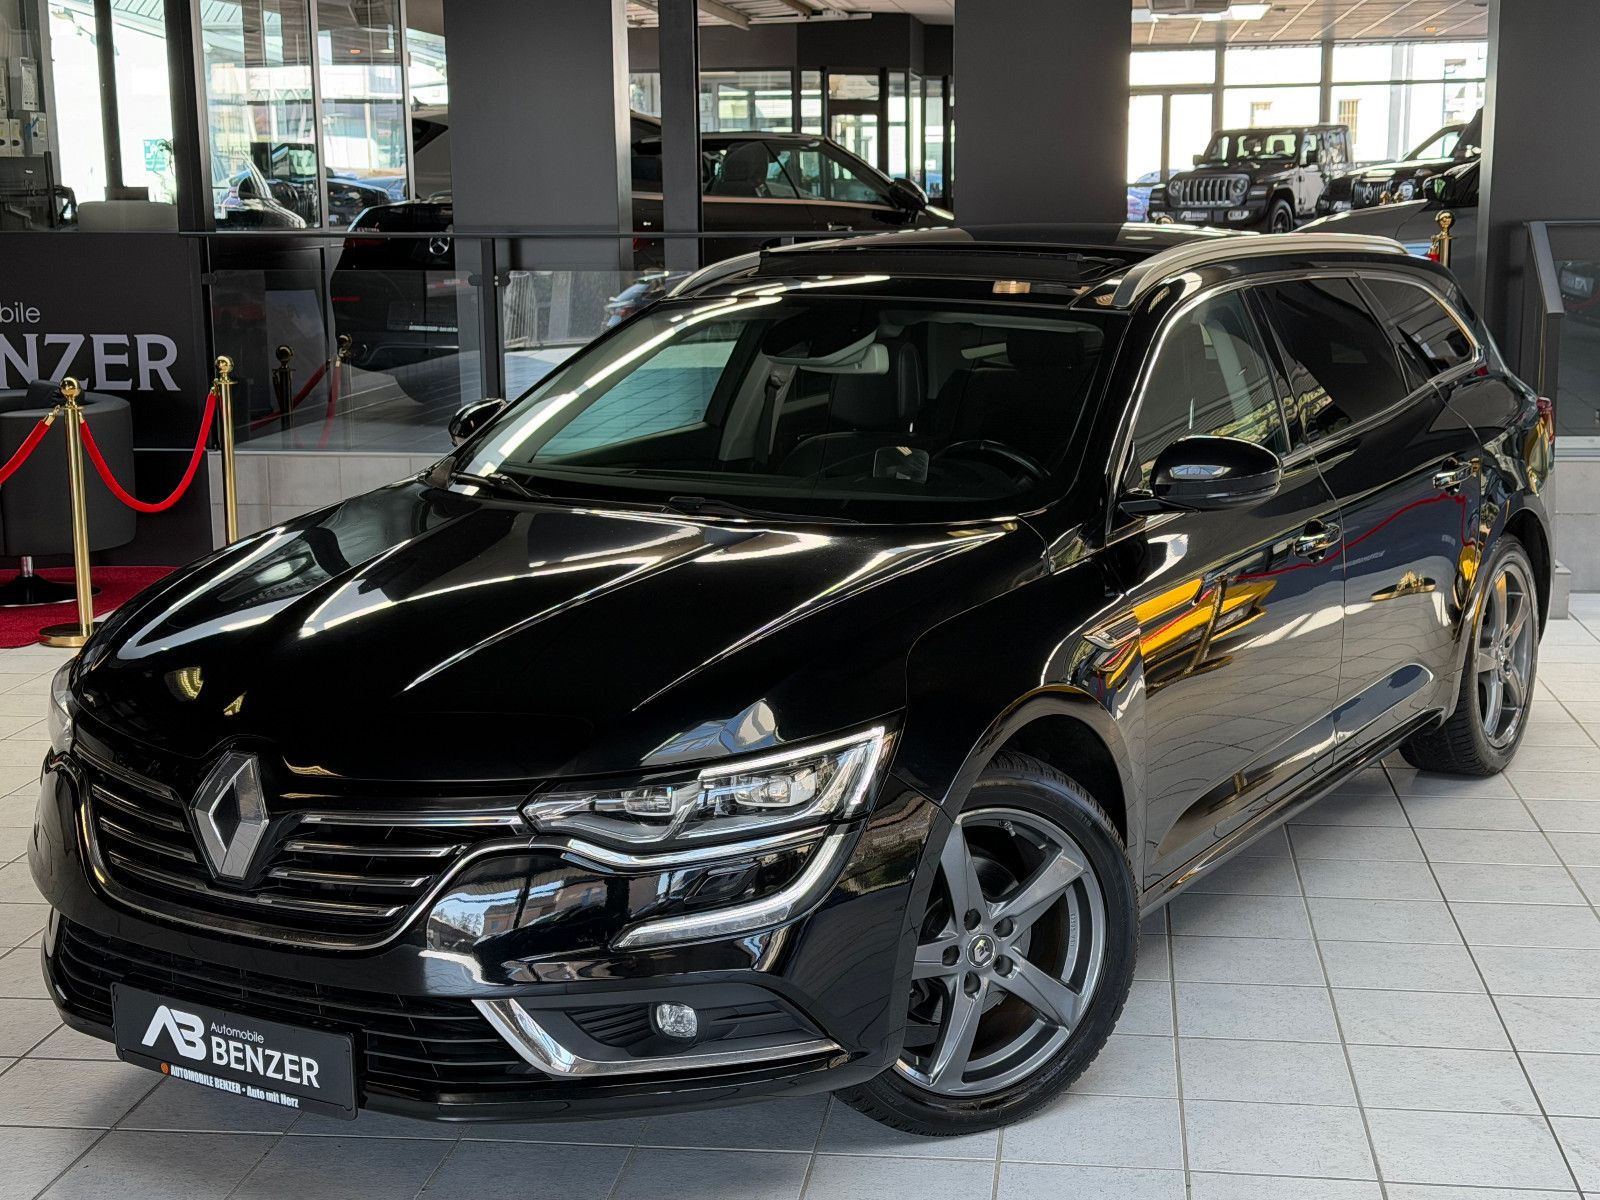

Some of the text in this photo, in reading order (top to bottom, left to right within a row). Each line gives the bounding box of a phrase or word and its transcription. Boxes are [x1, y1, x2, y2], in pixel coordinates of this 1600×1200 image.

[0, 302, 41, 324] bile
[0, 333, 181, 392] NZER
[141, 1005, 206, 1061] AB
[210, 1021, 265, 1044] Automobile
[170, 1064, 300, 1109] AUTOMOBILE BENZER Auto mit Herz
[211, 1036, 321, 1089] BENZER
